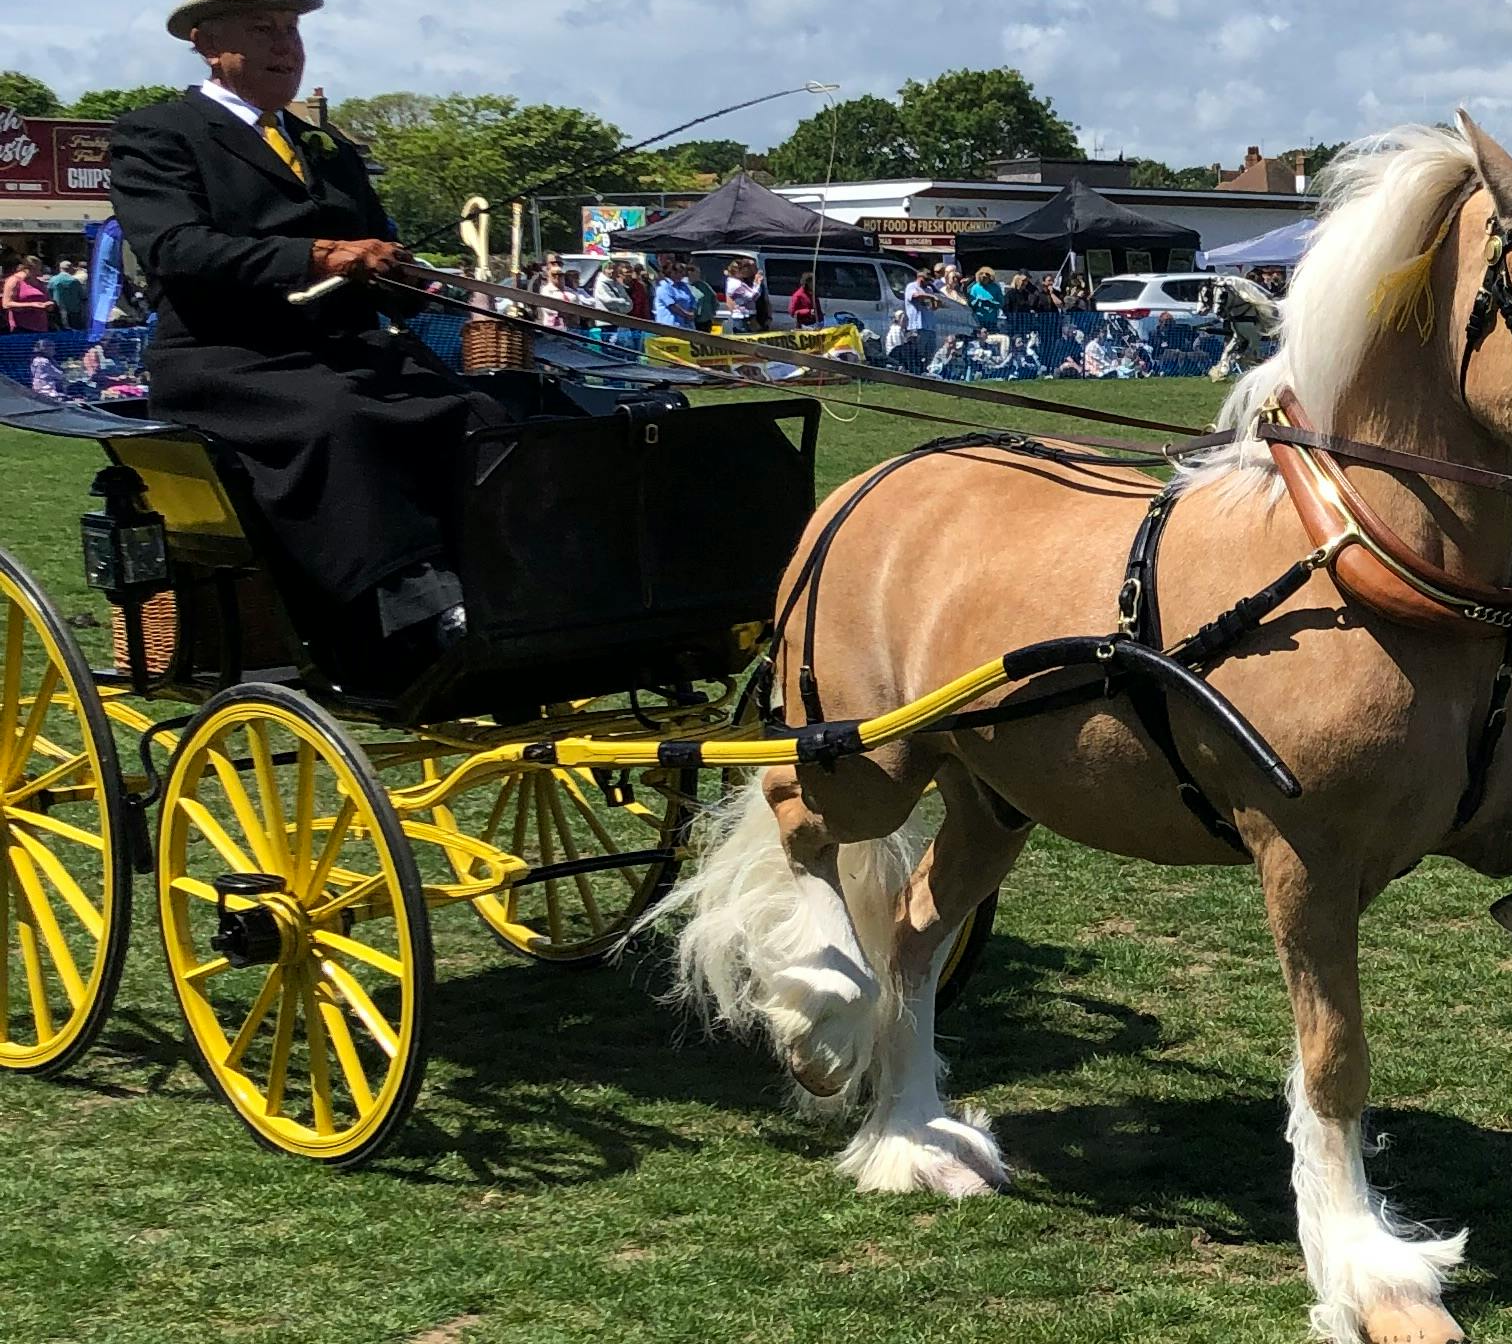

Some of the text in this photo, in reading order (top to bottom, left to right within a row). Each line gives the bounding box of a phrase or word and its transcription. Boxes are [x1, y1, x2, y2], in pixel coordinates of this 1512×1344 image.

[68, 168, 111, 189] CHIPS
[863, 219, 881, 231] HOT
[883, 219, 908, 232] FOOD
[909, 219, 917, 233] &
[918, 220, 944, 233] FRESH
